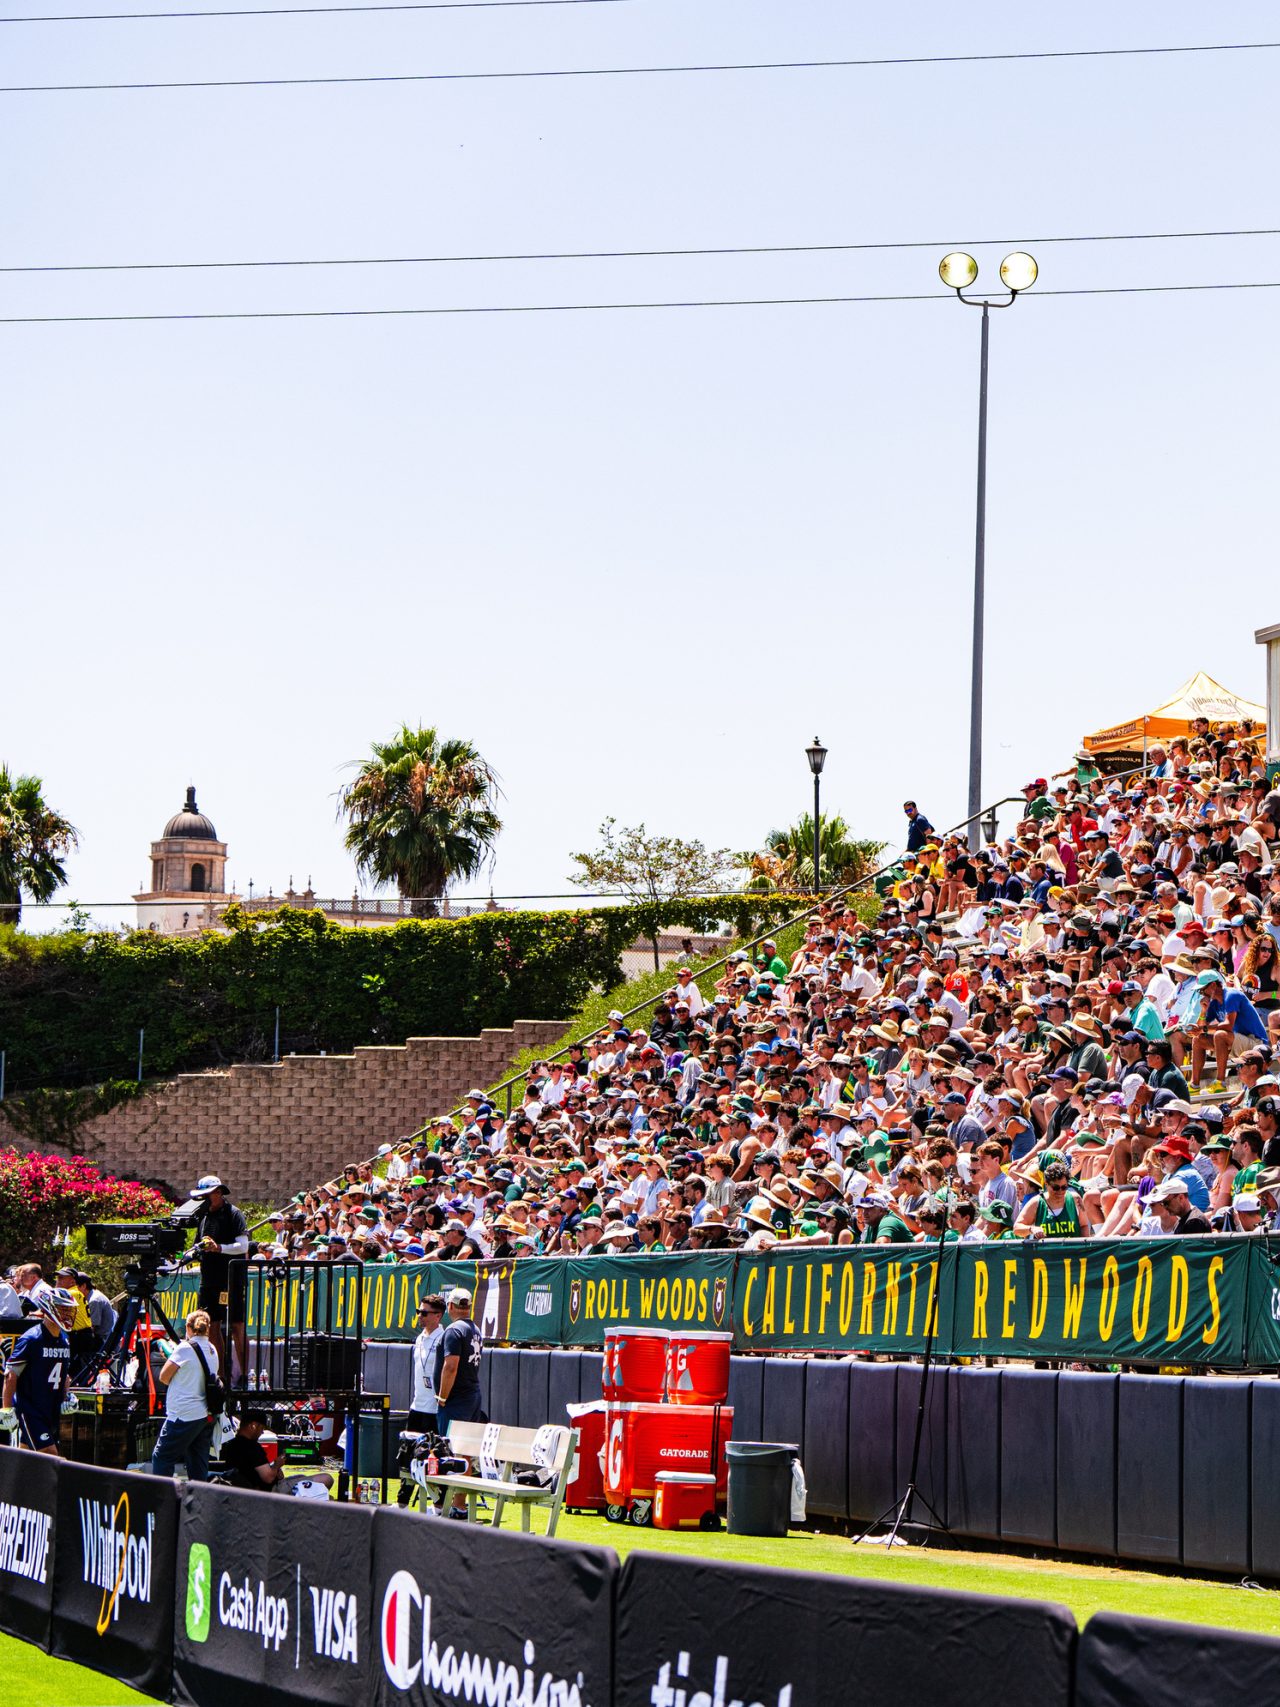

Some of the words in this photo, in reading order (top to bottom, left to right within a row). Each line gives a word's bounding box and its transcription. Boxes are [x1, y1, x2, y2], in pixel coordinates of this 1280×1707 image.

[953, 977, 962, 987] 16
[119, 1233, 138, 1241] ROSS
[585, 1278, 630, 1319] ROLL
[640, 1277, 709, 1322] WOODS
[743, 1260, 939, 1336] CALIFORNIA
[971, 1255, 1224, 1345] REDWOODS
[43, 1347, 70, 1358] BOSTO
[48, 1362, 63, 1390] 4
[659, 1448, 709, 1459] GATORADE
[0, 1502, 52, 1584] GRESSIVE
[80, 1497, 152, 1621] Whirlpool
[219, 1571, 253, 1632] Cash
[255, 1580, 289, 1651] App
[309, 1586, 358, 1664] VISA
